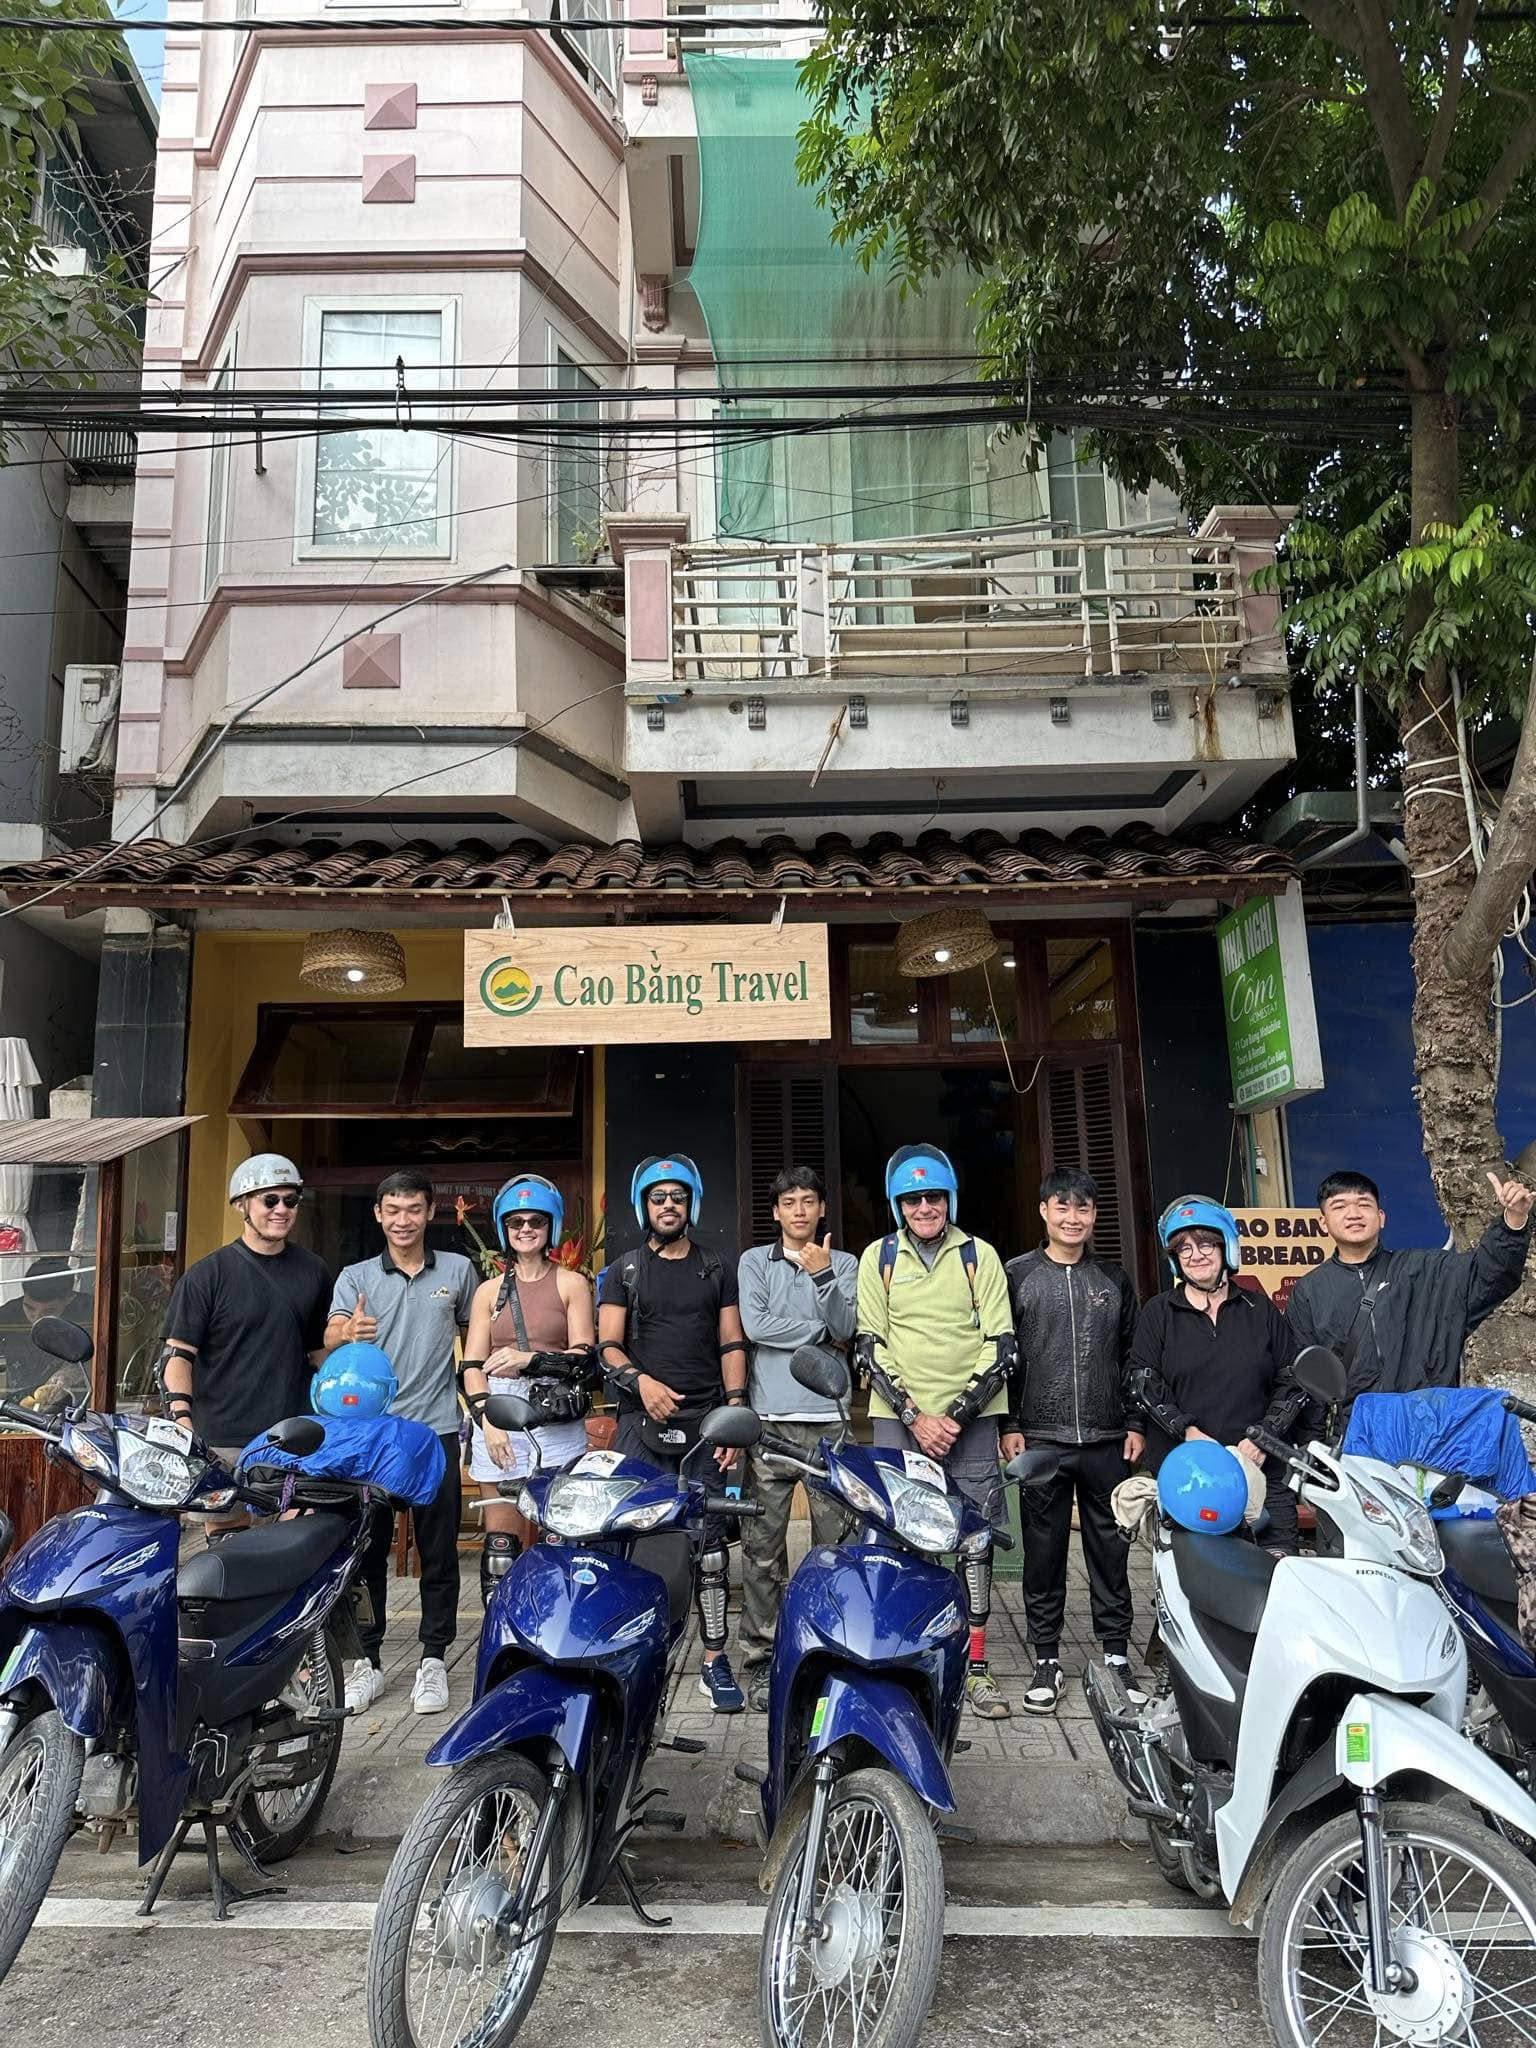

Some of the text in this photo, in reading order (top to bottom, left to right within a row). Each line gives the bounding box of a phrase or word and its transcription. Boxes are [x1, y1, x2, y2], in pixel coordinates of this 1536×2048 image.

[553, 950, 809, 1015] Cao Bằng Travel
[1235, 1218, 1328, 1237] AO BAN
[1240, 1246, 1325, 1265] BREAD
[571, 1556, 610, 1571] HONDA
[863, 1555, 903, 1569] HONDA
[1356, 1569, 1398, 1583] HONDA
